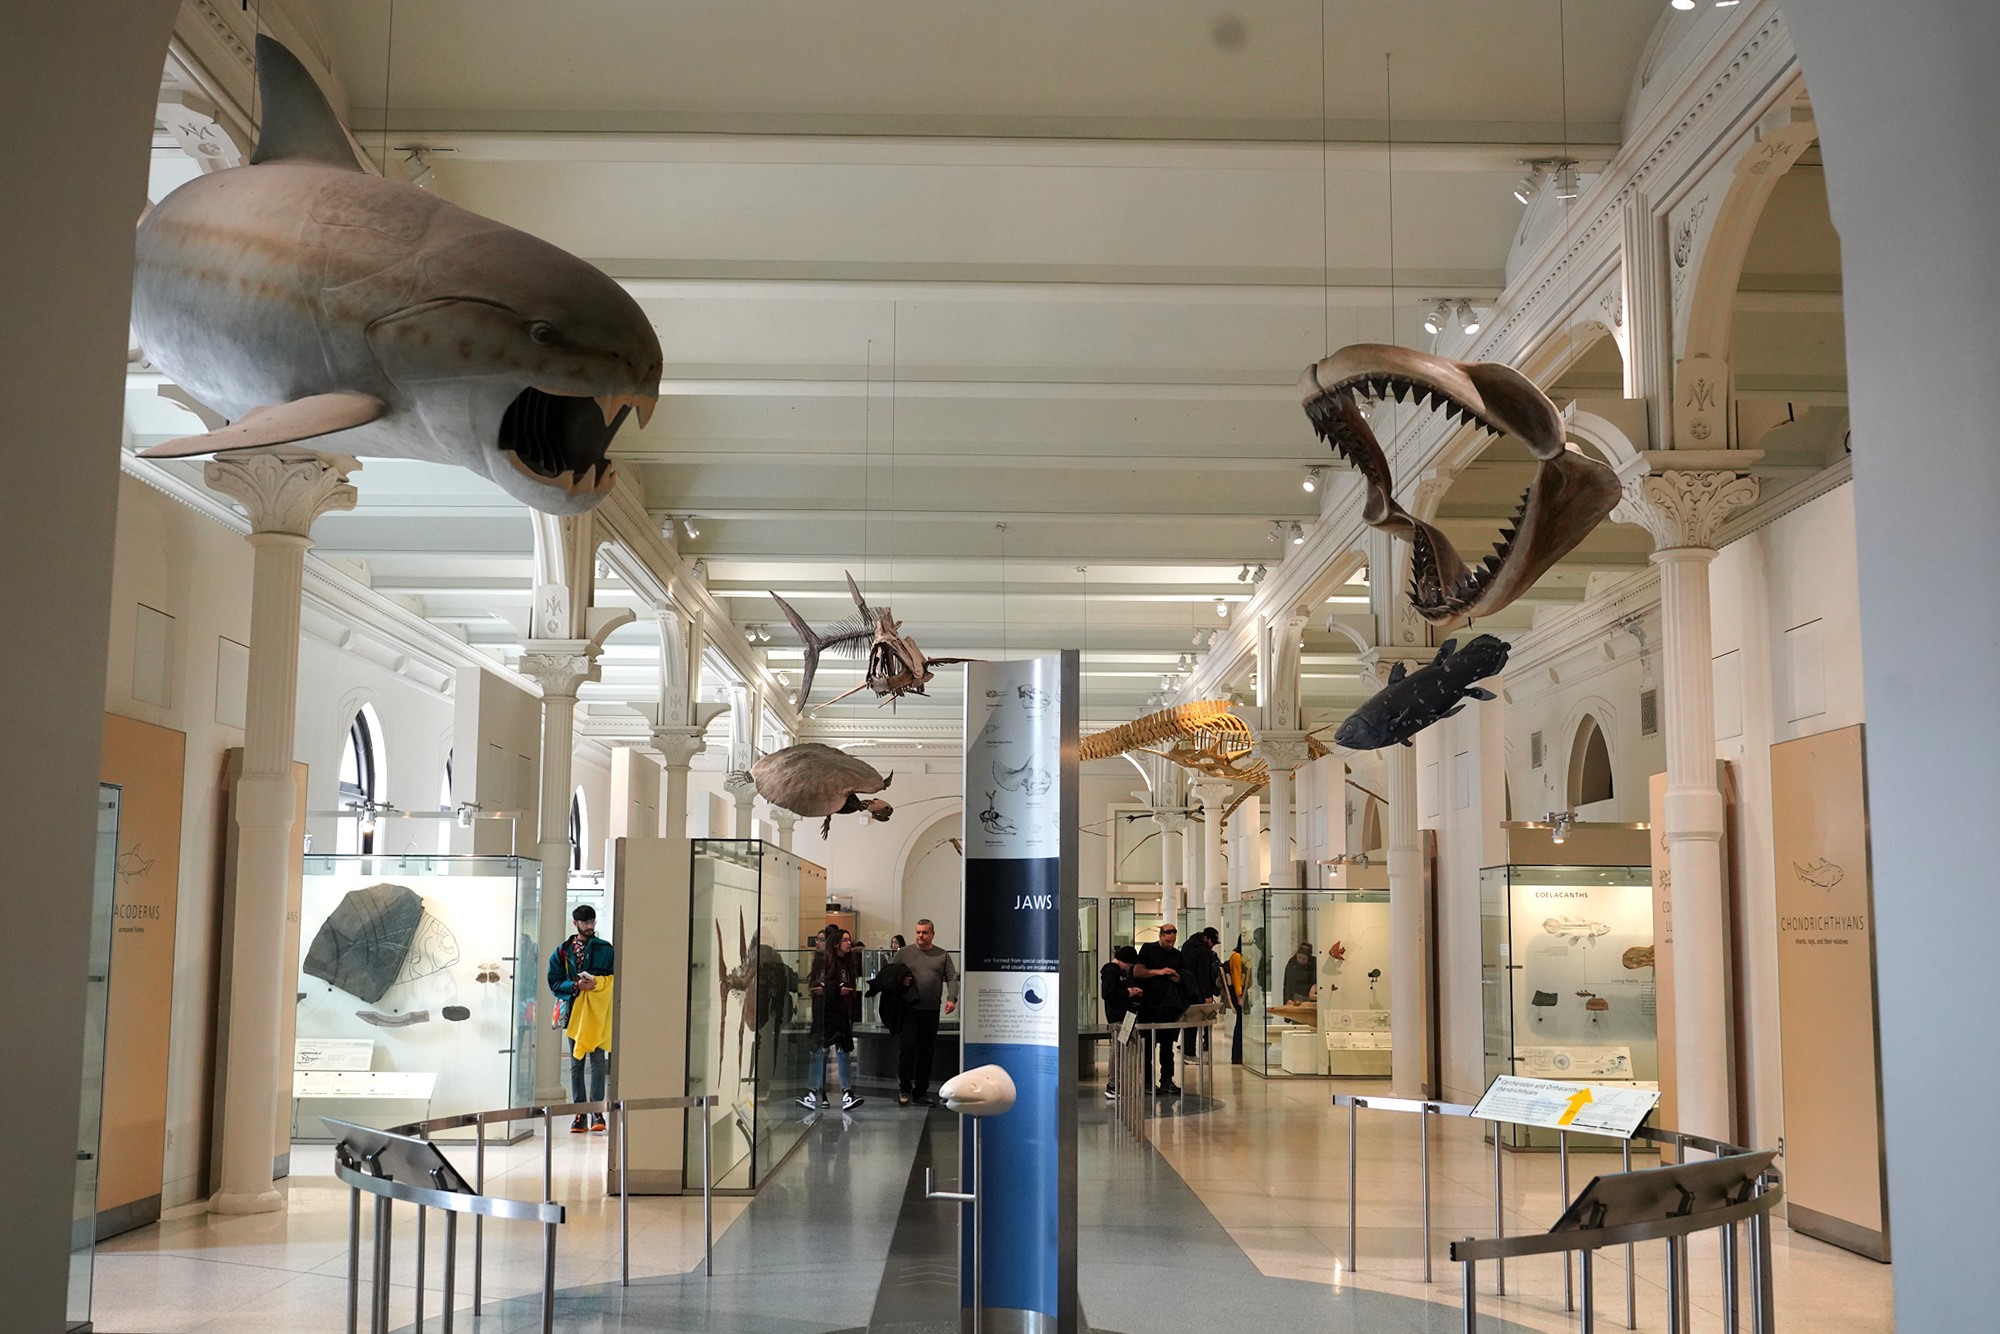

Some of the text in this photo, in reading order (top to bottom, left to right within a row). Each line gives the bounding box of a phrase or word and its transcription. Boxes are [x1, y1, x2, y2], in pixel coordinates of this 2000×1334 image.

[1535, 891, 1589, 899] COELACANTHS
[1014, 894, 1053, 910] JAWS
[1780, 915, 1865, 931] CHONDRICHTHYANS
[1501, 1079, 1534, 1088] Carcharodon
[1496, 1085, 1538, 1096] chondrichthyans
